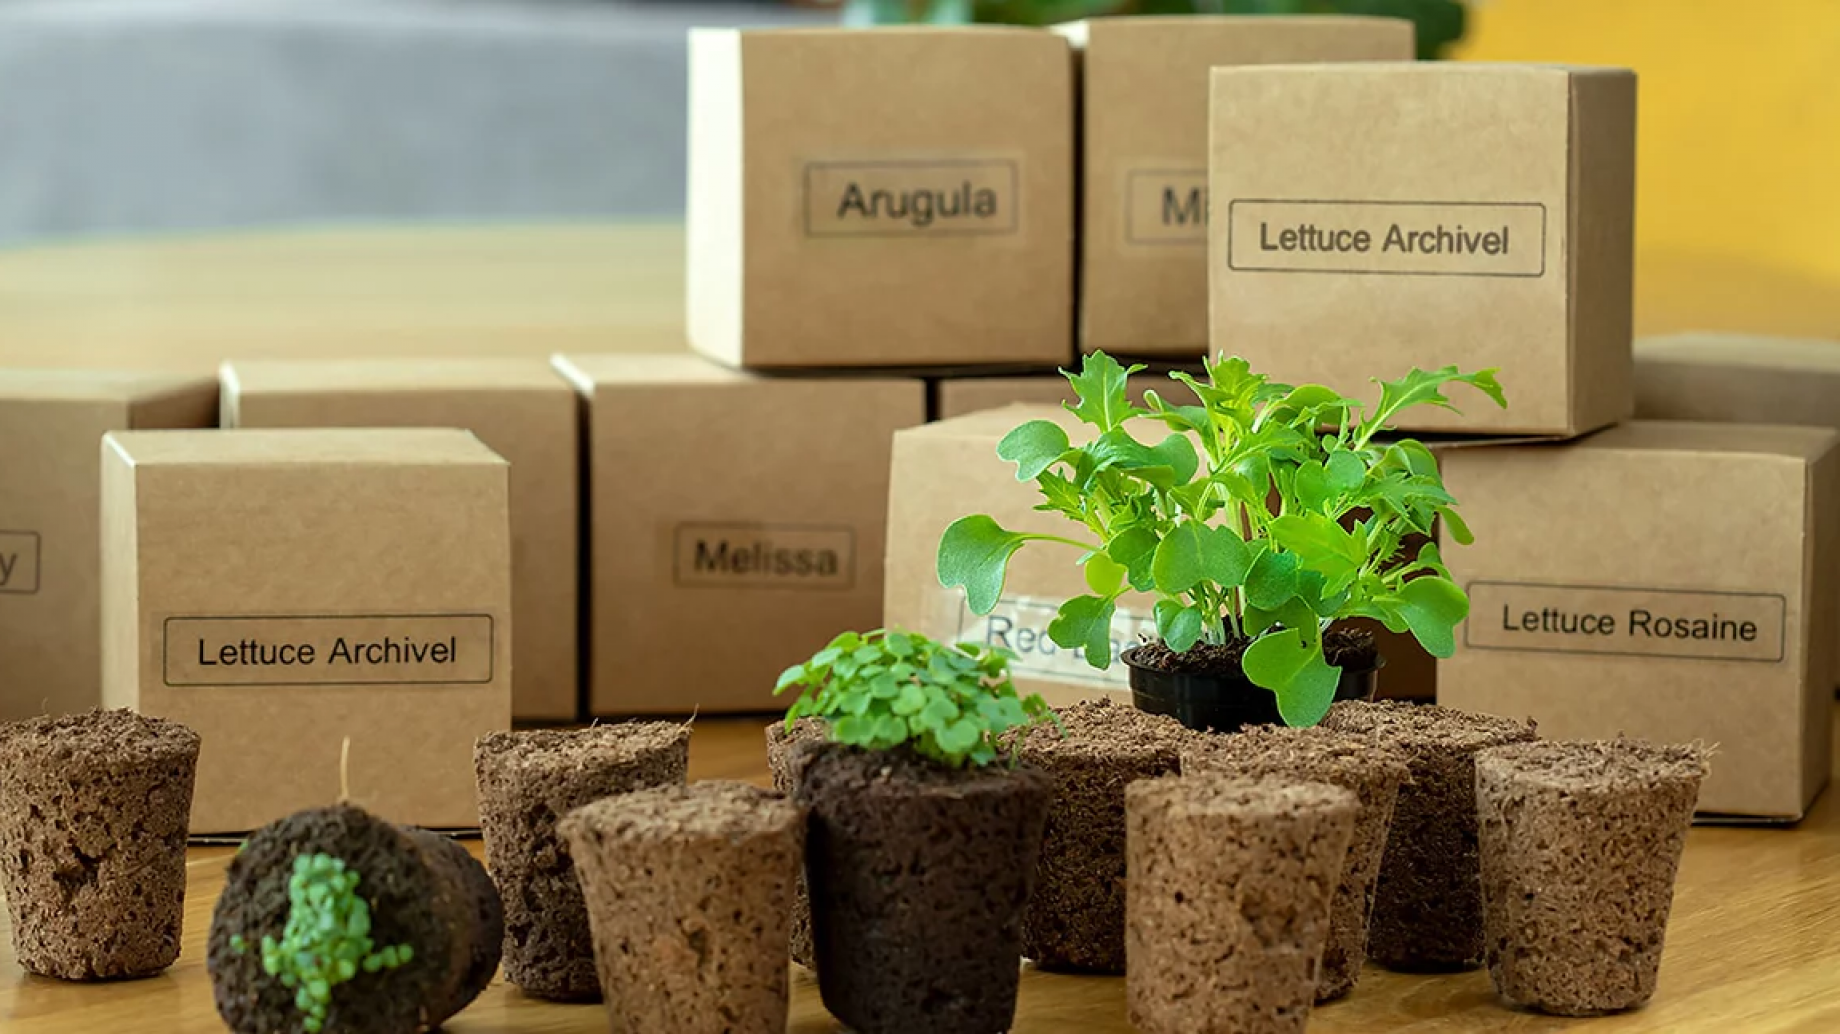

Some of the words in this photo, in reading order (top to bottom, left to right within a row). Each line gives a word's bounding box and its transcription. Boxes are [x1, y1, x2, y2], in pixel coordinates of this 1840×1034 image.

[836, 179, 998, 229] Arugula
[1259, 221, 1371, 253] Lettuce
[1380, 222, 1510, 255] Archivel
[694, 538, 839, 576] Melissa
[1502, 603, 1616, 637] Lettuce
[1628, 609, 1758, 643] Rosaine
[198, 636, 316, 666] Lettuce
[327, 635, 456, 665] Archivel
